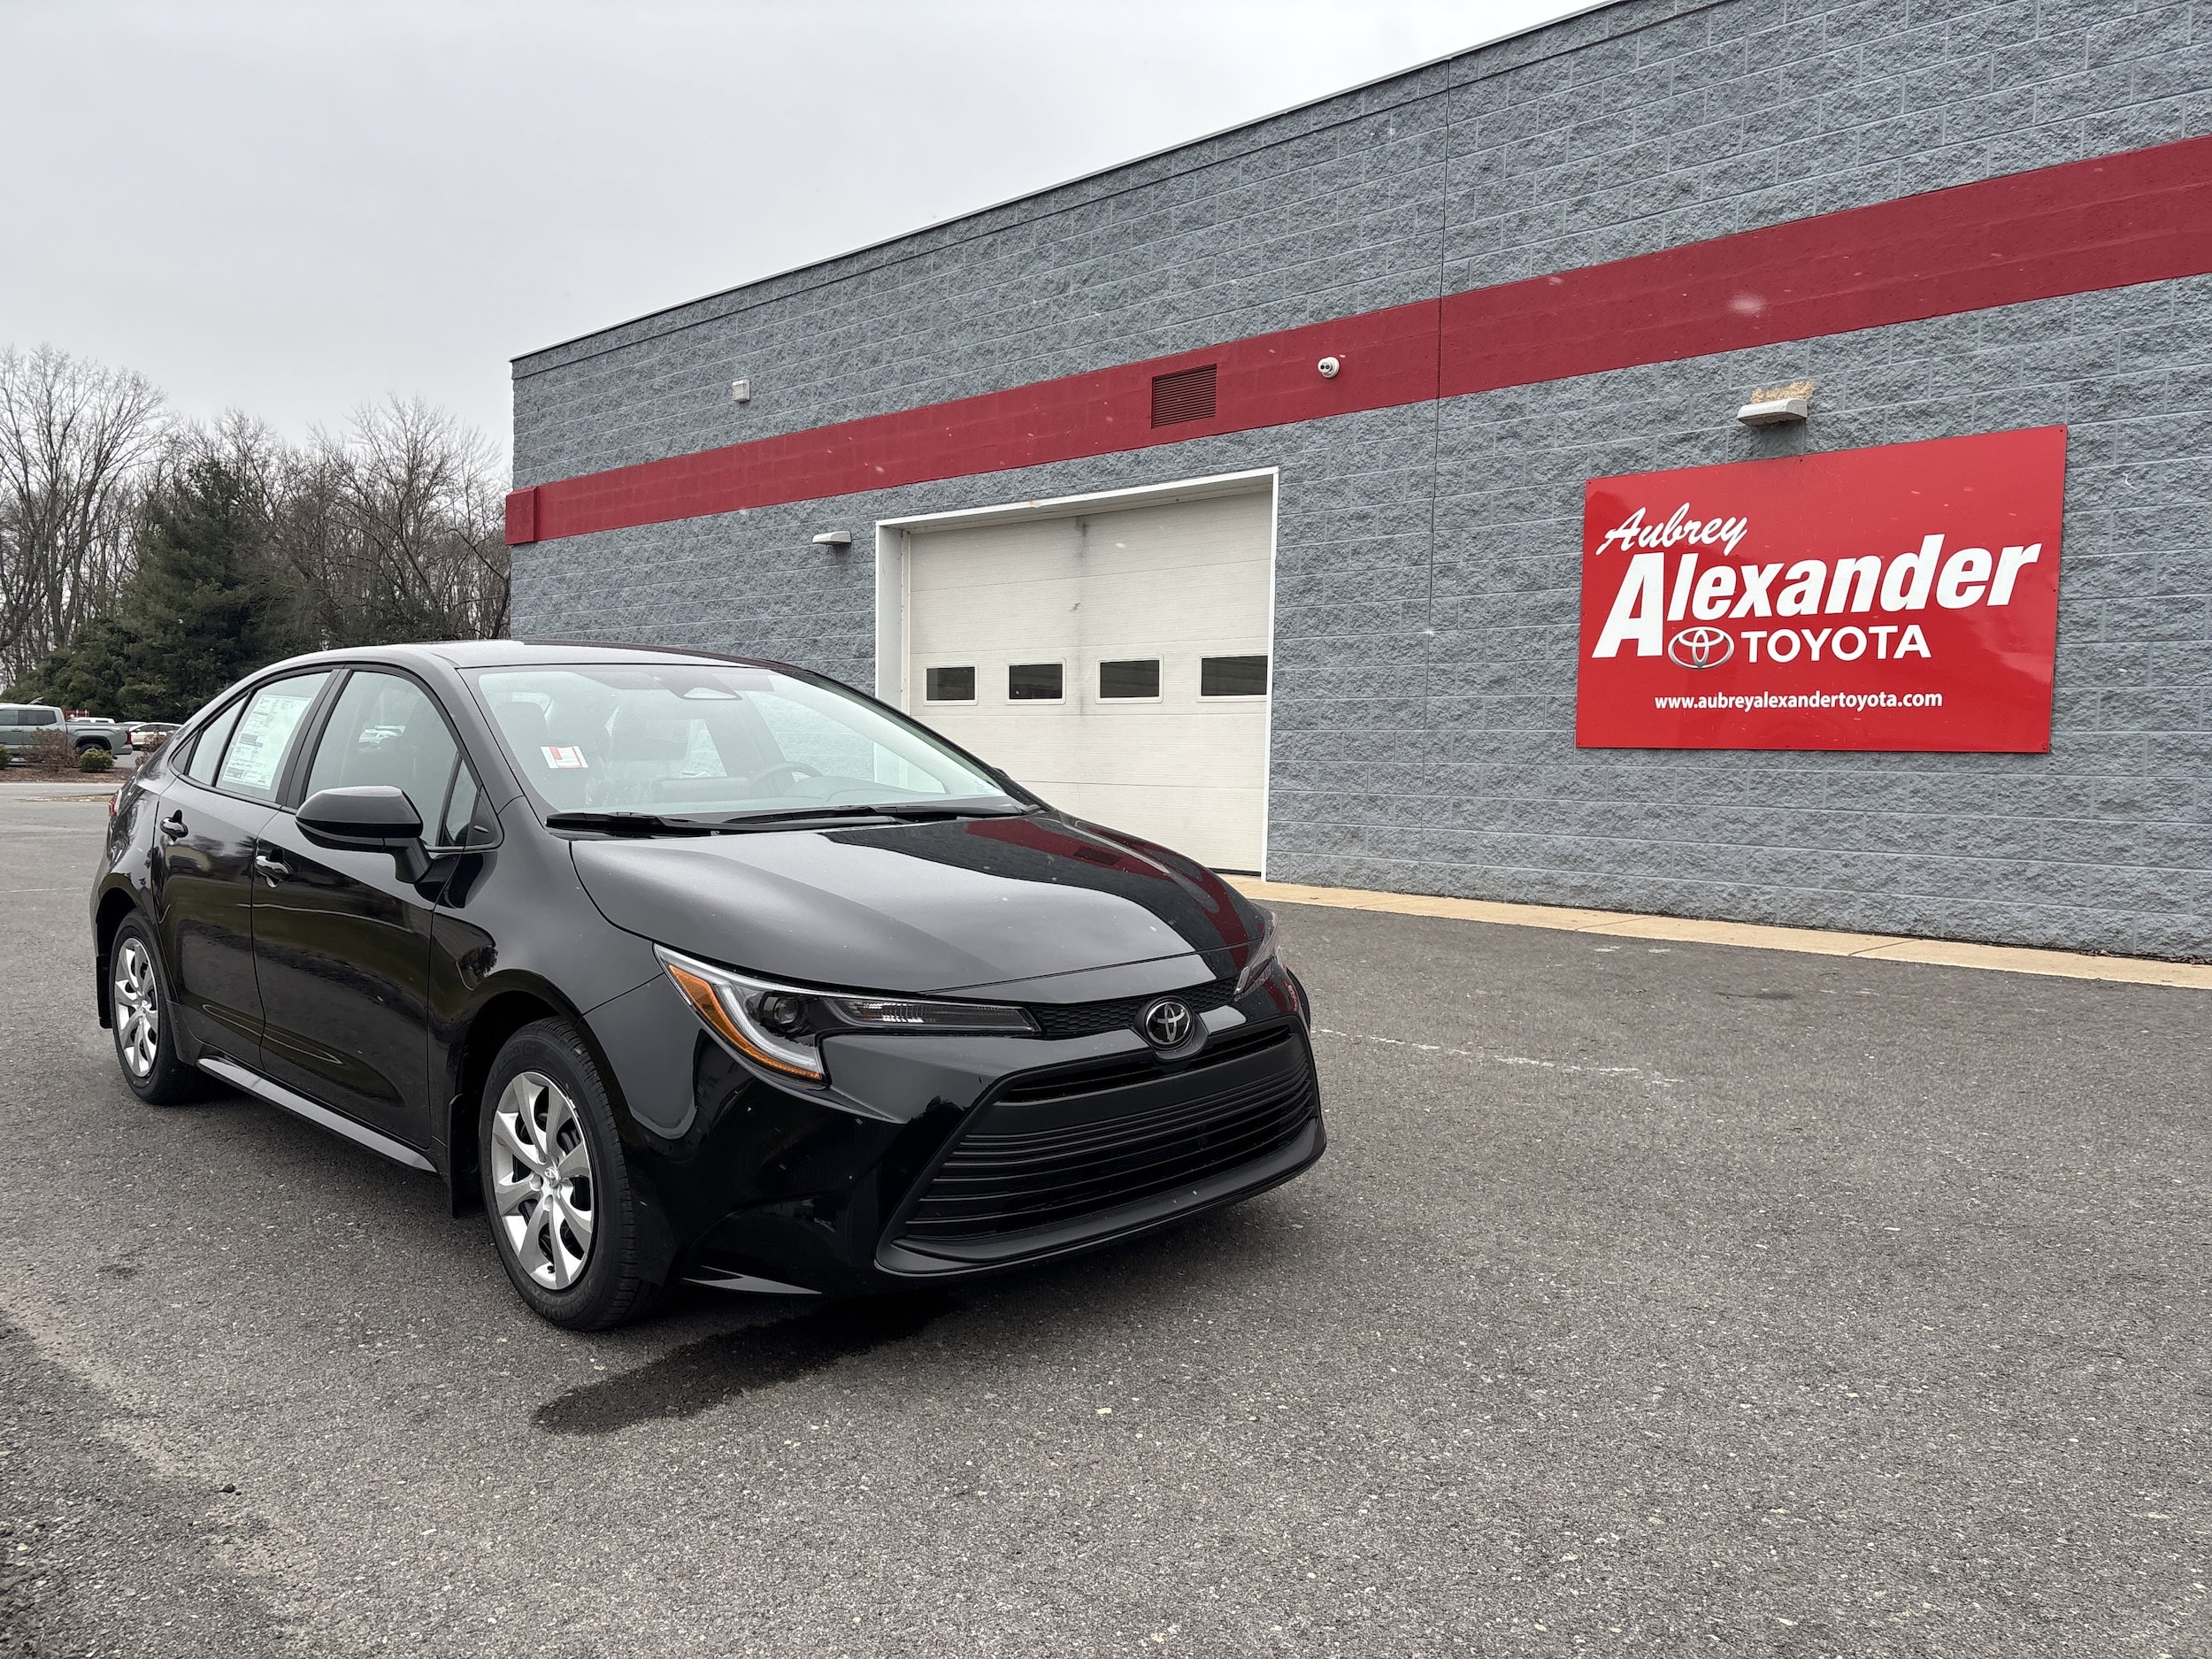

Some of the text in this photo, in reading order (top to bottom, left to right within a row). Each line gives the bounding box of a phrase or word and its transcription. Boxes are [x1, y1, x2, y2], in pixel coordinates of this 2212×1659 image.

[1595, 502, 1747, 557] Aubrey
[1591, 534, 2042, 658] Alexander
[1740, 624, 1932, 663] TOYOTA
[1654, 690, 1943, 713] www.aubreyalexandertoyota.com
